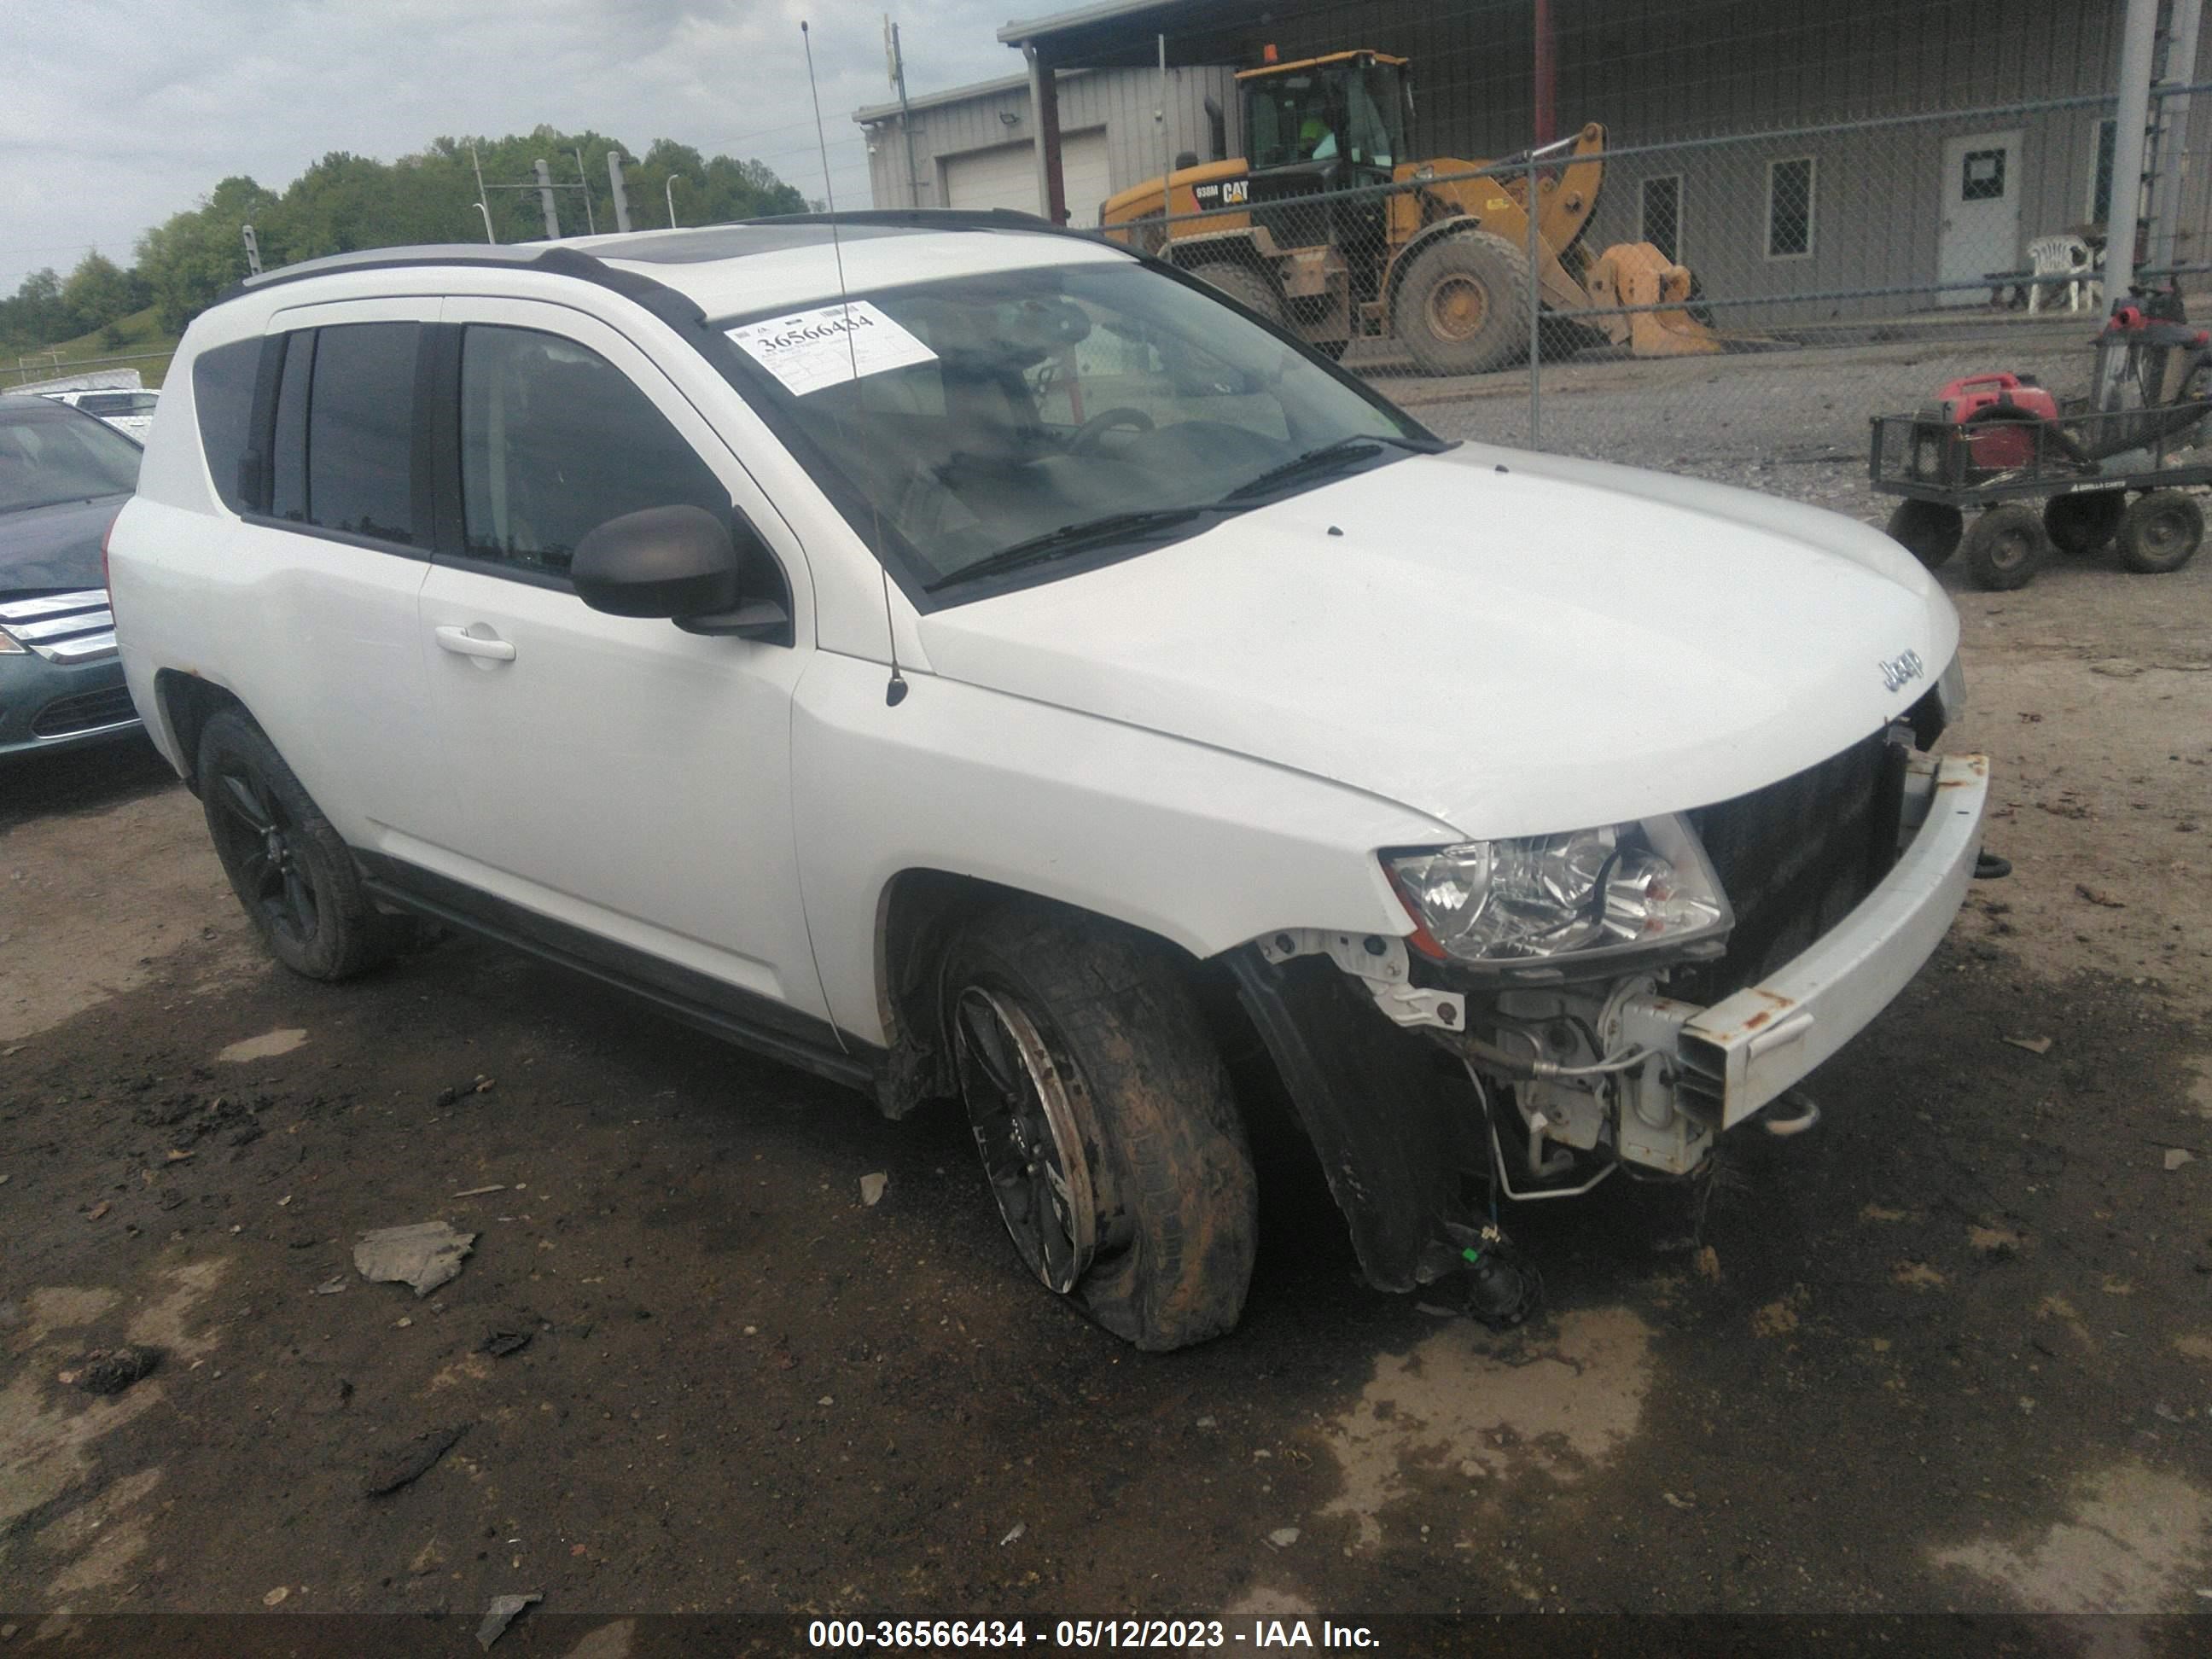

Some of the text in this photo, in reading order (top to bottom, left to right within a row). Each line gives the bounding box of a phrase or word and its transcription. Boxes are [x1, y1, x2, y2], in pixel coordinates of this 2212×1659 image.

[1223, 180, 1249, 203] CAT
[757, 314, 875, 352] 36566434
[1878, 648, 1924, 692] Jeep
